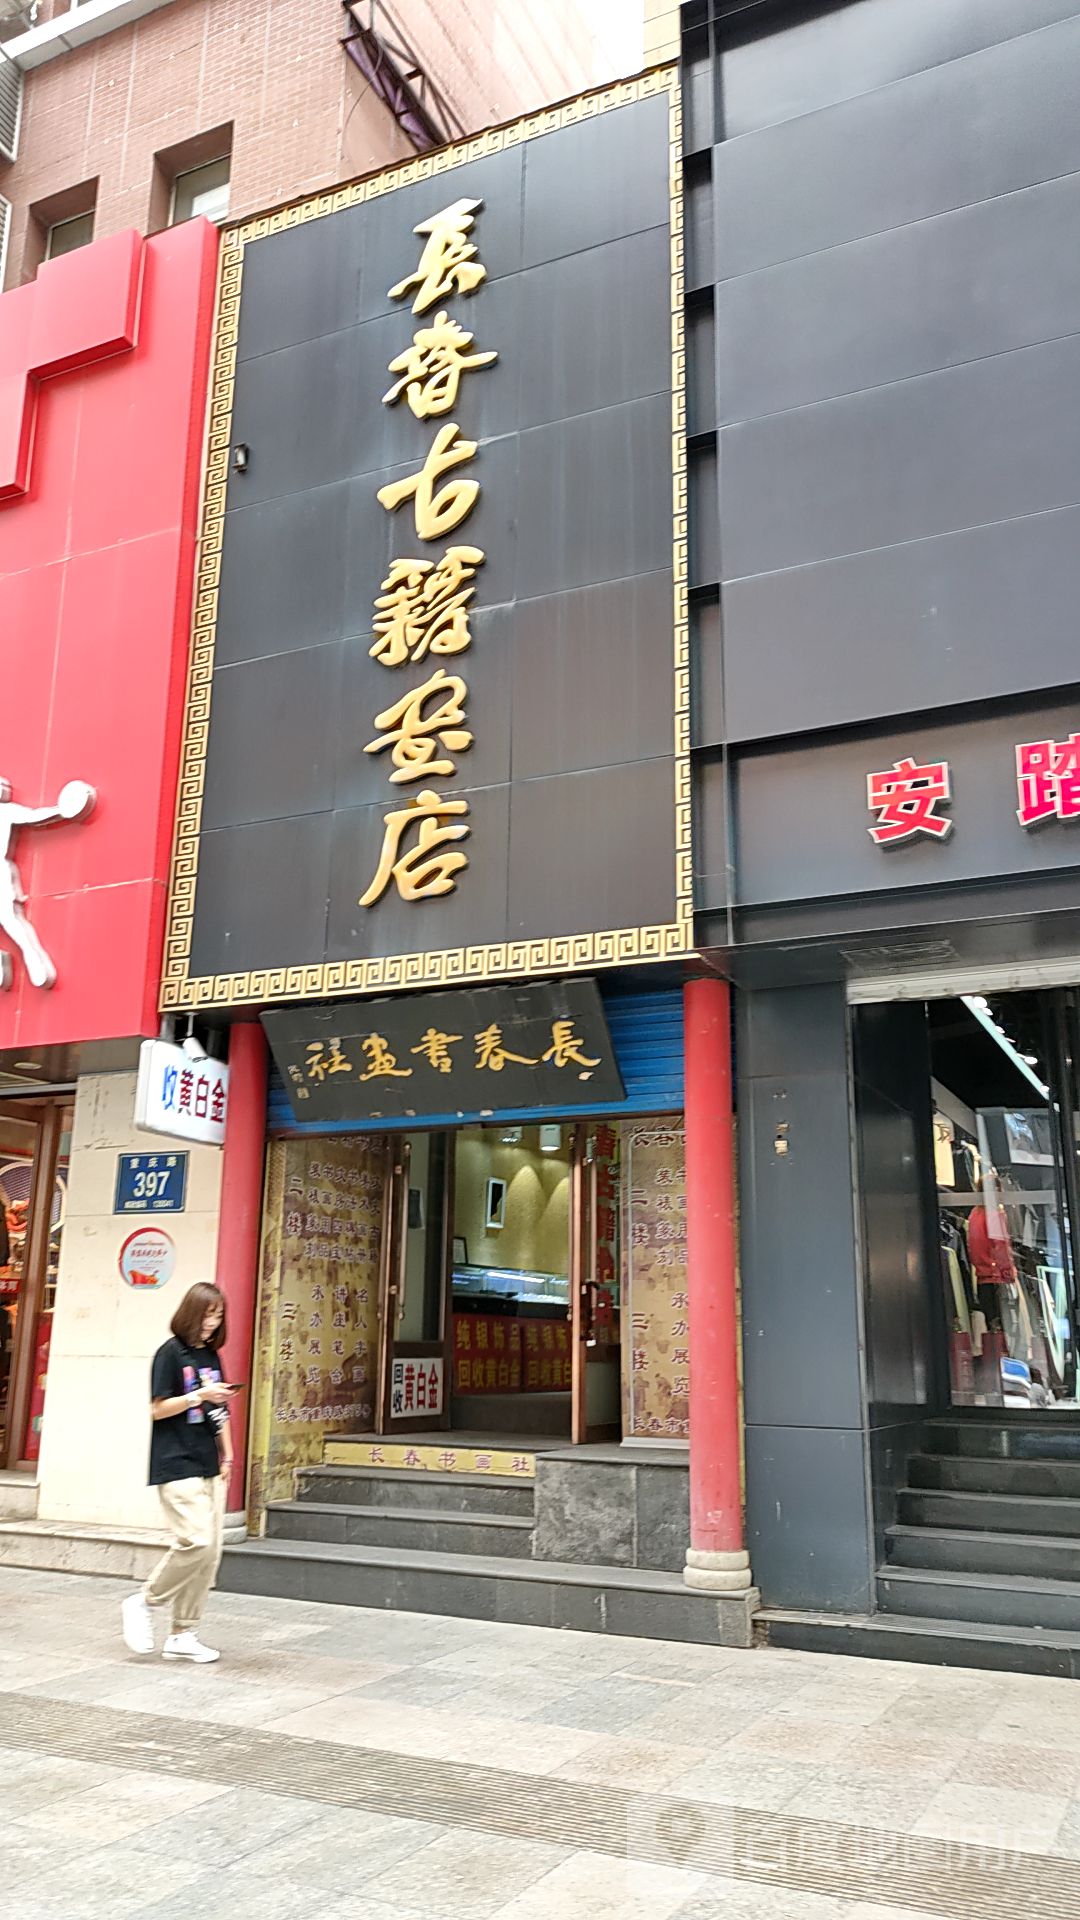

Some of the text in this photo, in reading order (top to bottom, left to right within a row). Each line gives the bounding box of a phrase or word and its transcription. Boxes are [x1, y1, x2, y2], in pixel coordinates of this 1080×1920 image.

[133, 1171, 170, 1197] 397
[369, 1447, 530, 1472] 长春书画社
